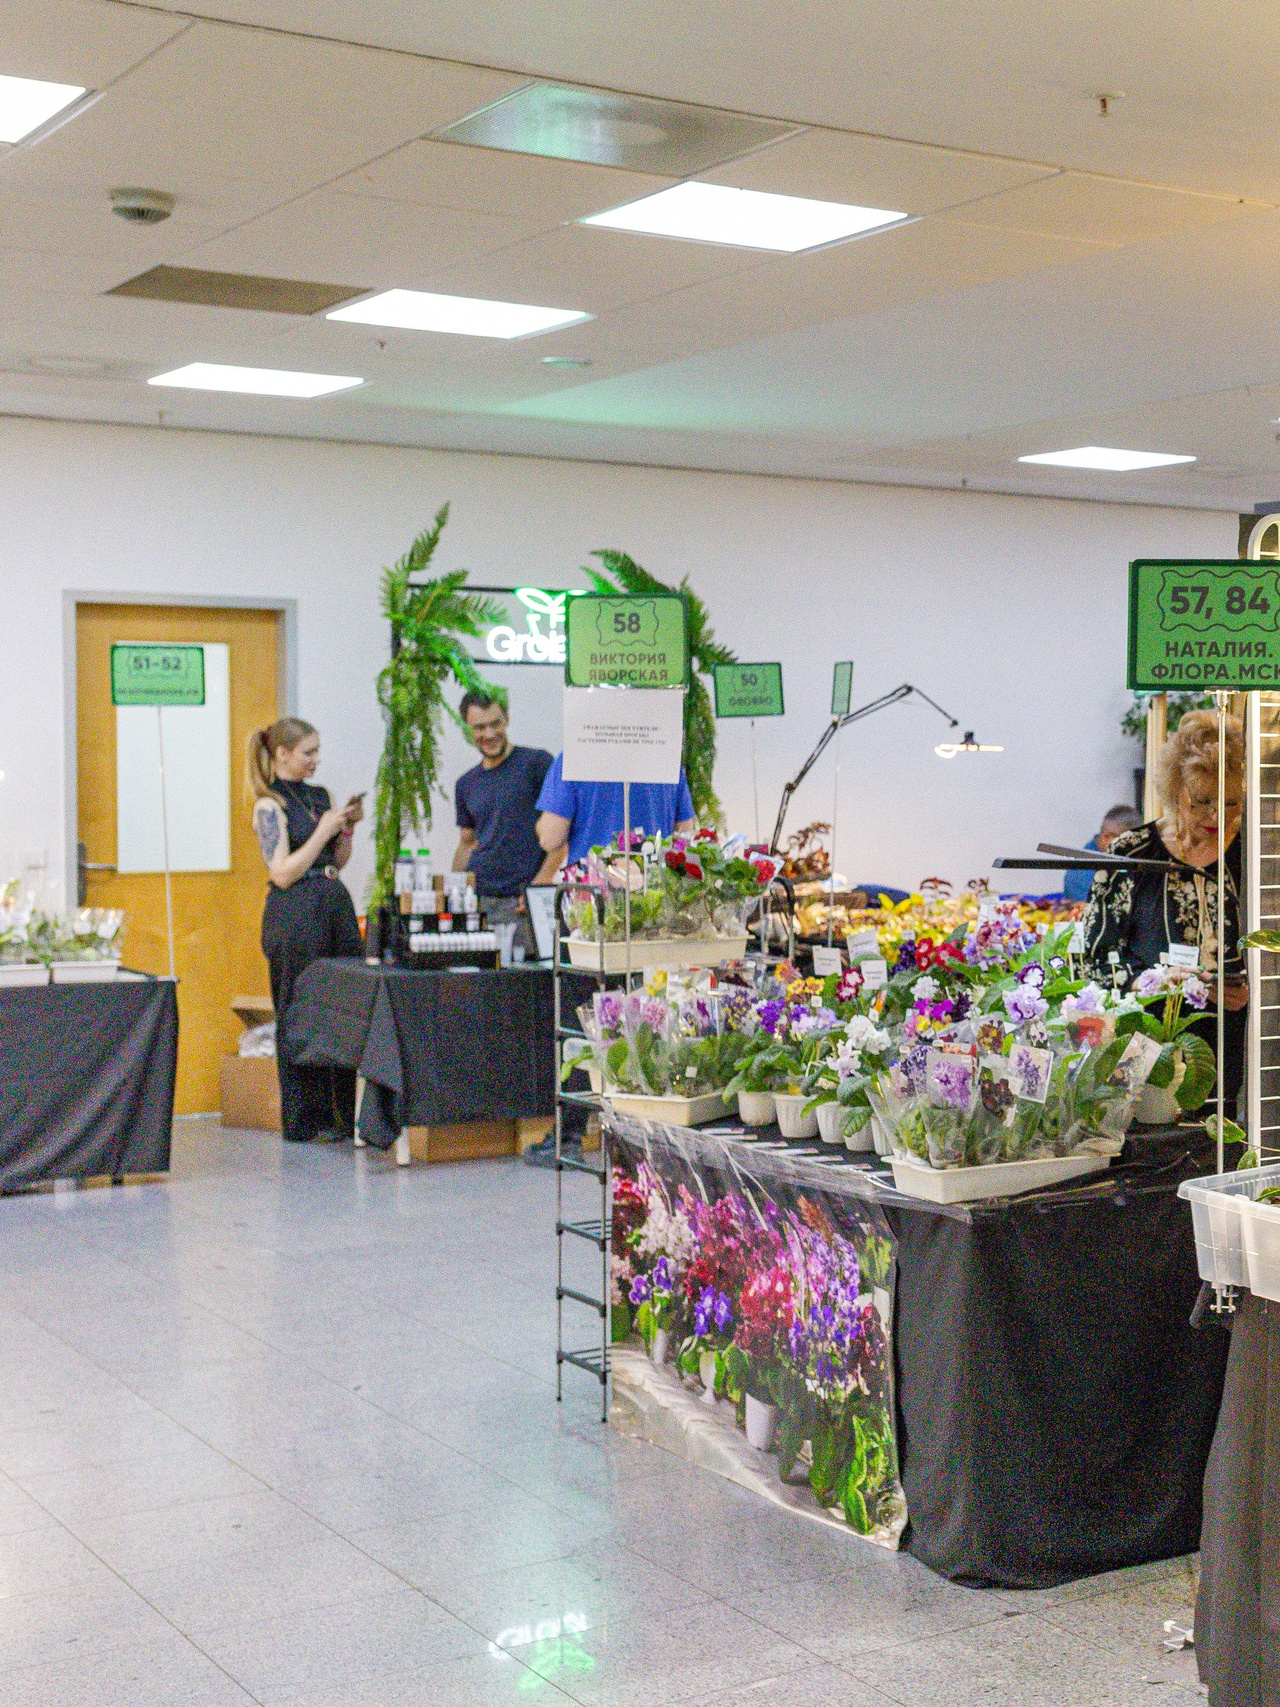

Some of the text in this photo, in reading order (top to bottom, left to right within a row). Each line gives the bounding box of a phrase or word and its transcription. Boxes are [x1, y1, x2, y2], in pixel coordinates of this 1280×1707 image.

[1169, 585, 1270, 620] 57, 84
[613, 612, 641, 634] 58
[1165, 641, 1273, 659] НАТАЛИЯ.
[133, 656, 181, 671] 51-52
[589, 652, 667, 665] ВИКТОРИЯ
[588, 668, 668, 681] ЯВОРСКАЯ
